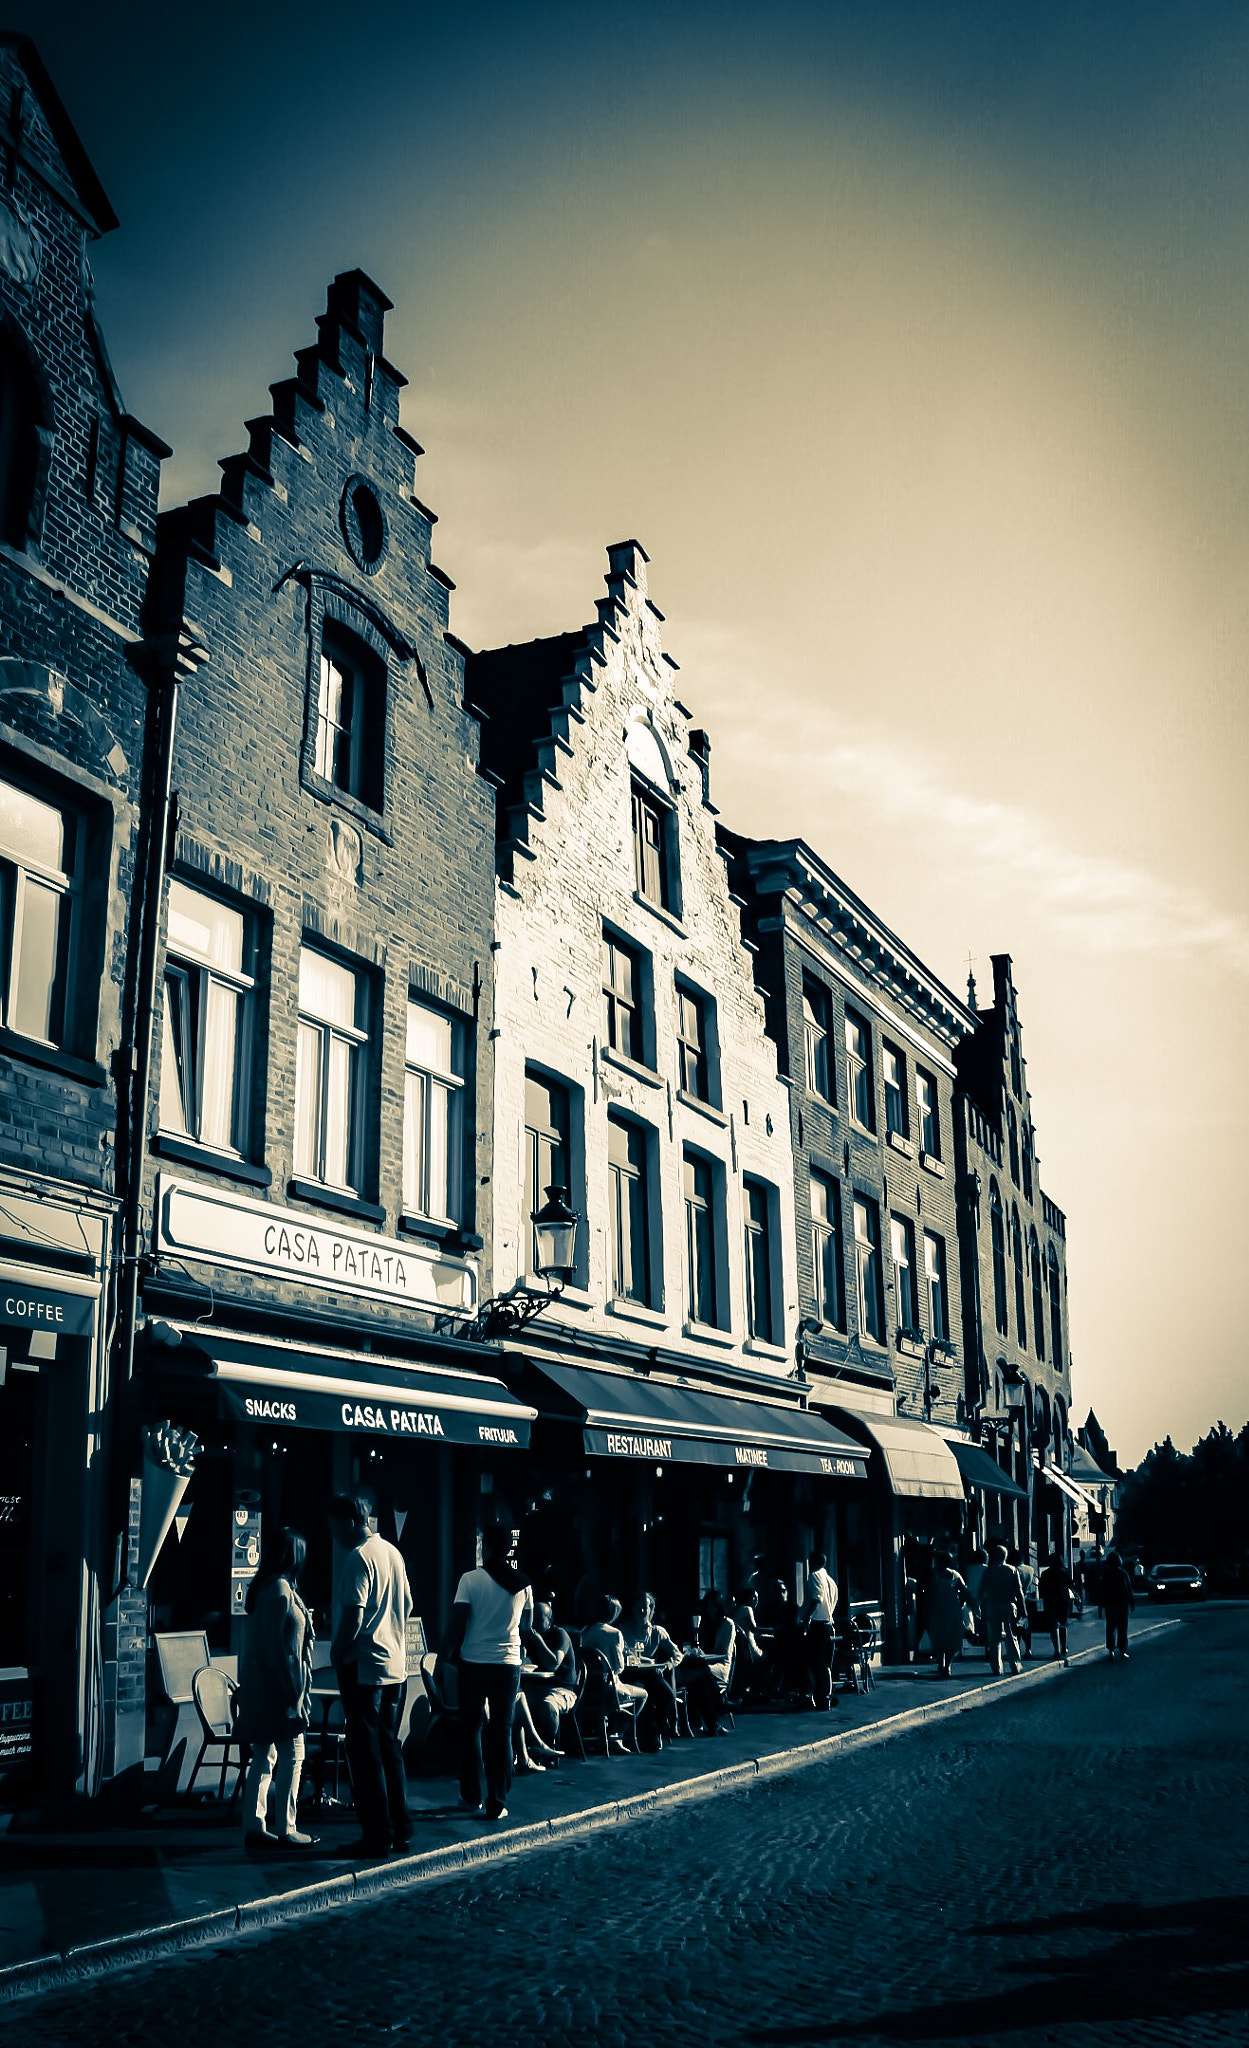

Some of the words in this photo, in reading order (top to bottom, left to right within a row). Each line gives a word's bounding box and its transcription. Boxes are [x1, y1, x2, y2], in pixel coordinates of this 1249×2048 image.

[264, 1225, 320, 1268] CASA
[332, 1242, 407, 1288] PATATA
[5, 1298, 65, 1322] COFFEE
[245, 1398, 297, 1421] SNACKS
[341, 1403, 388, 1430] CASA
[390, 1409, 445, 1436] PATATA
[478, 1425, 519, 1444] FRITUUR
[606, 1433, 673, 1458] RESTAURANT
[734, 1447, 769, 1467] MATINEE
[820, 1457, 834, 1473] TEA
[836, 1459, 856, 1475] ROOM
